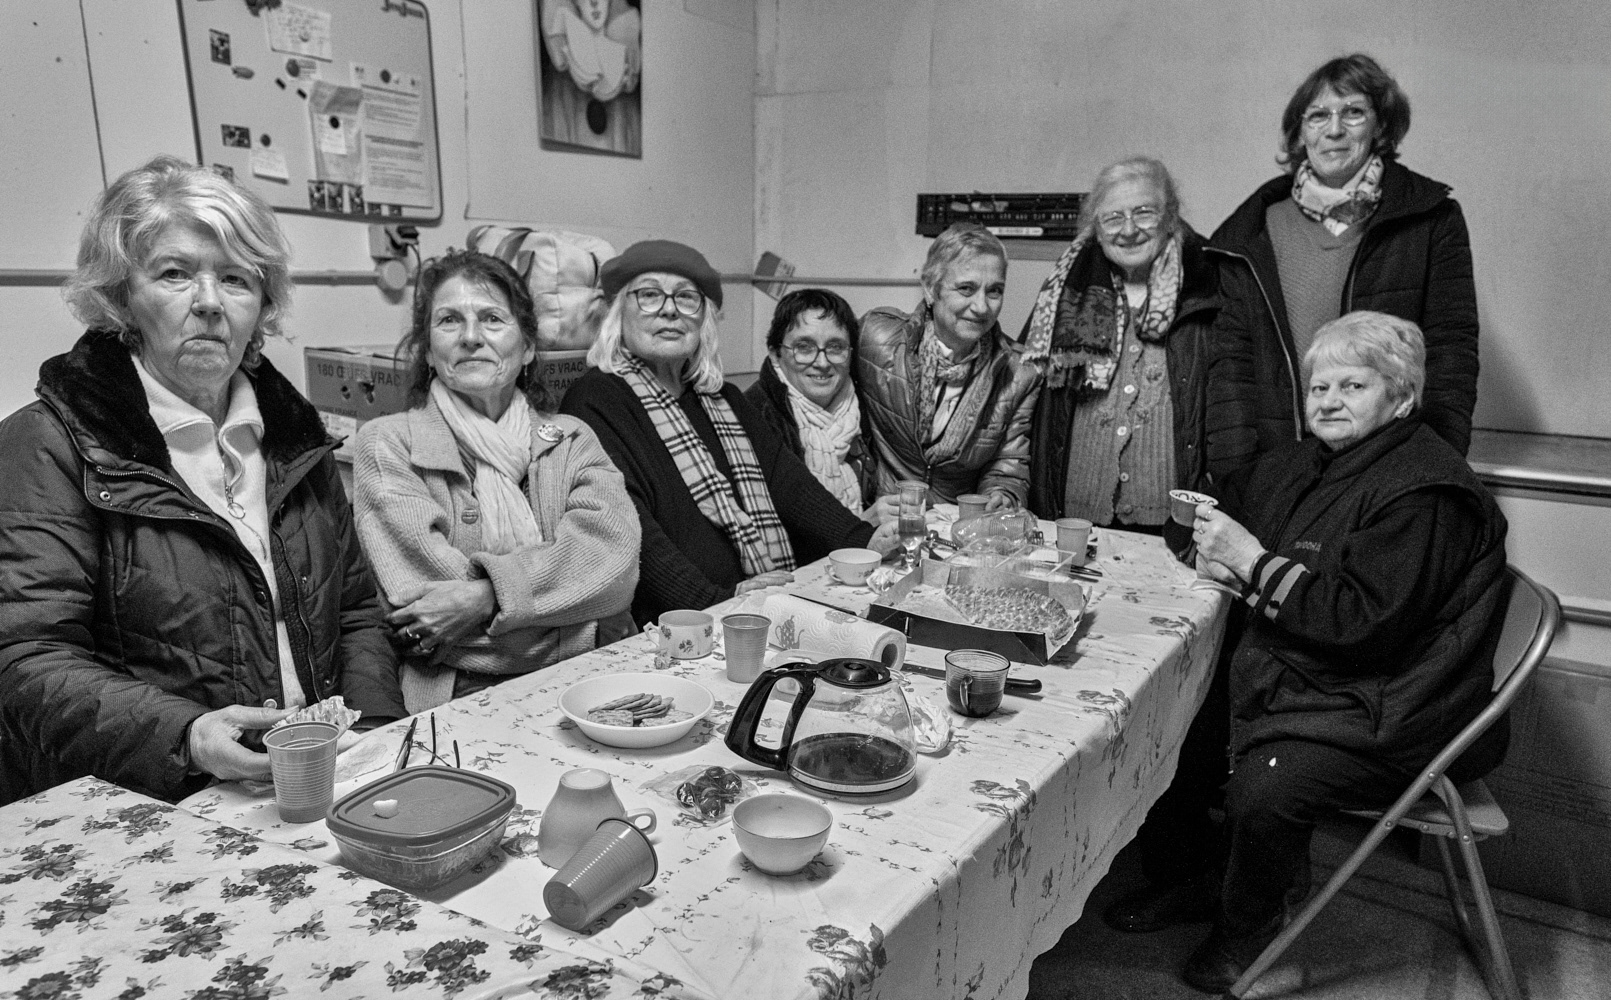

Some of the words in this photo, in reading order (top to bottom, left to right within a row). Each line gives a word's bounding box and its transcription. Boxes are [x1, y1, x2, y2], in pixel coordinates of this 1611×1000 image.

[317, 363, 334, 377] 180
[370, 371, 402, 387] VRAC
[557, 361, 584, 373] VRAC
